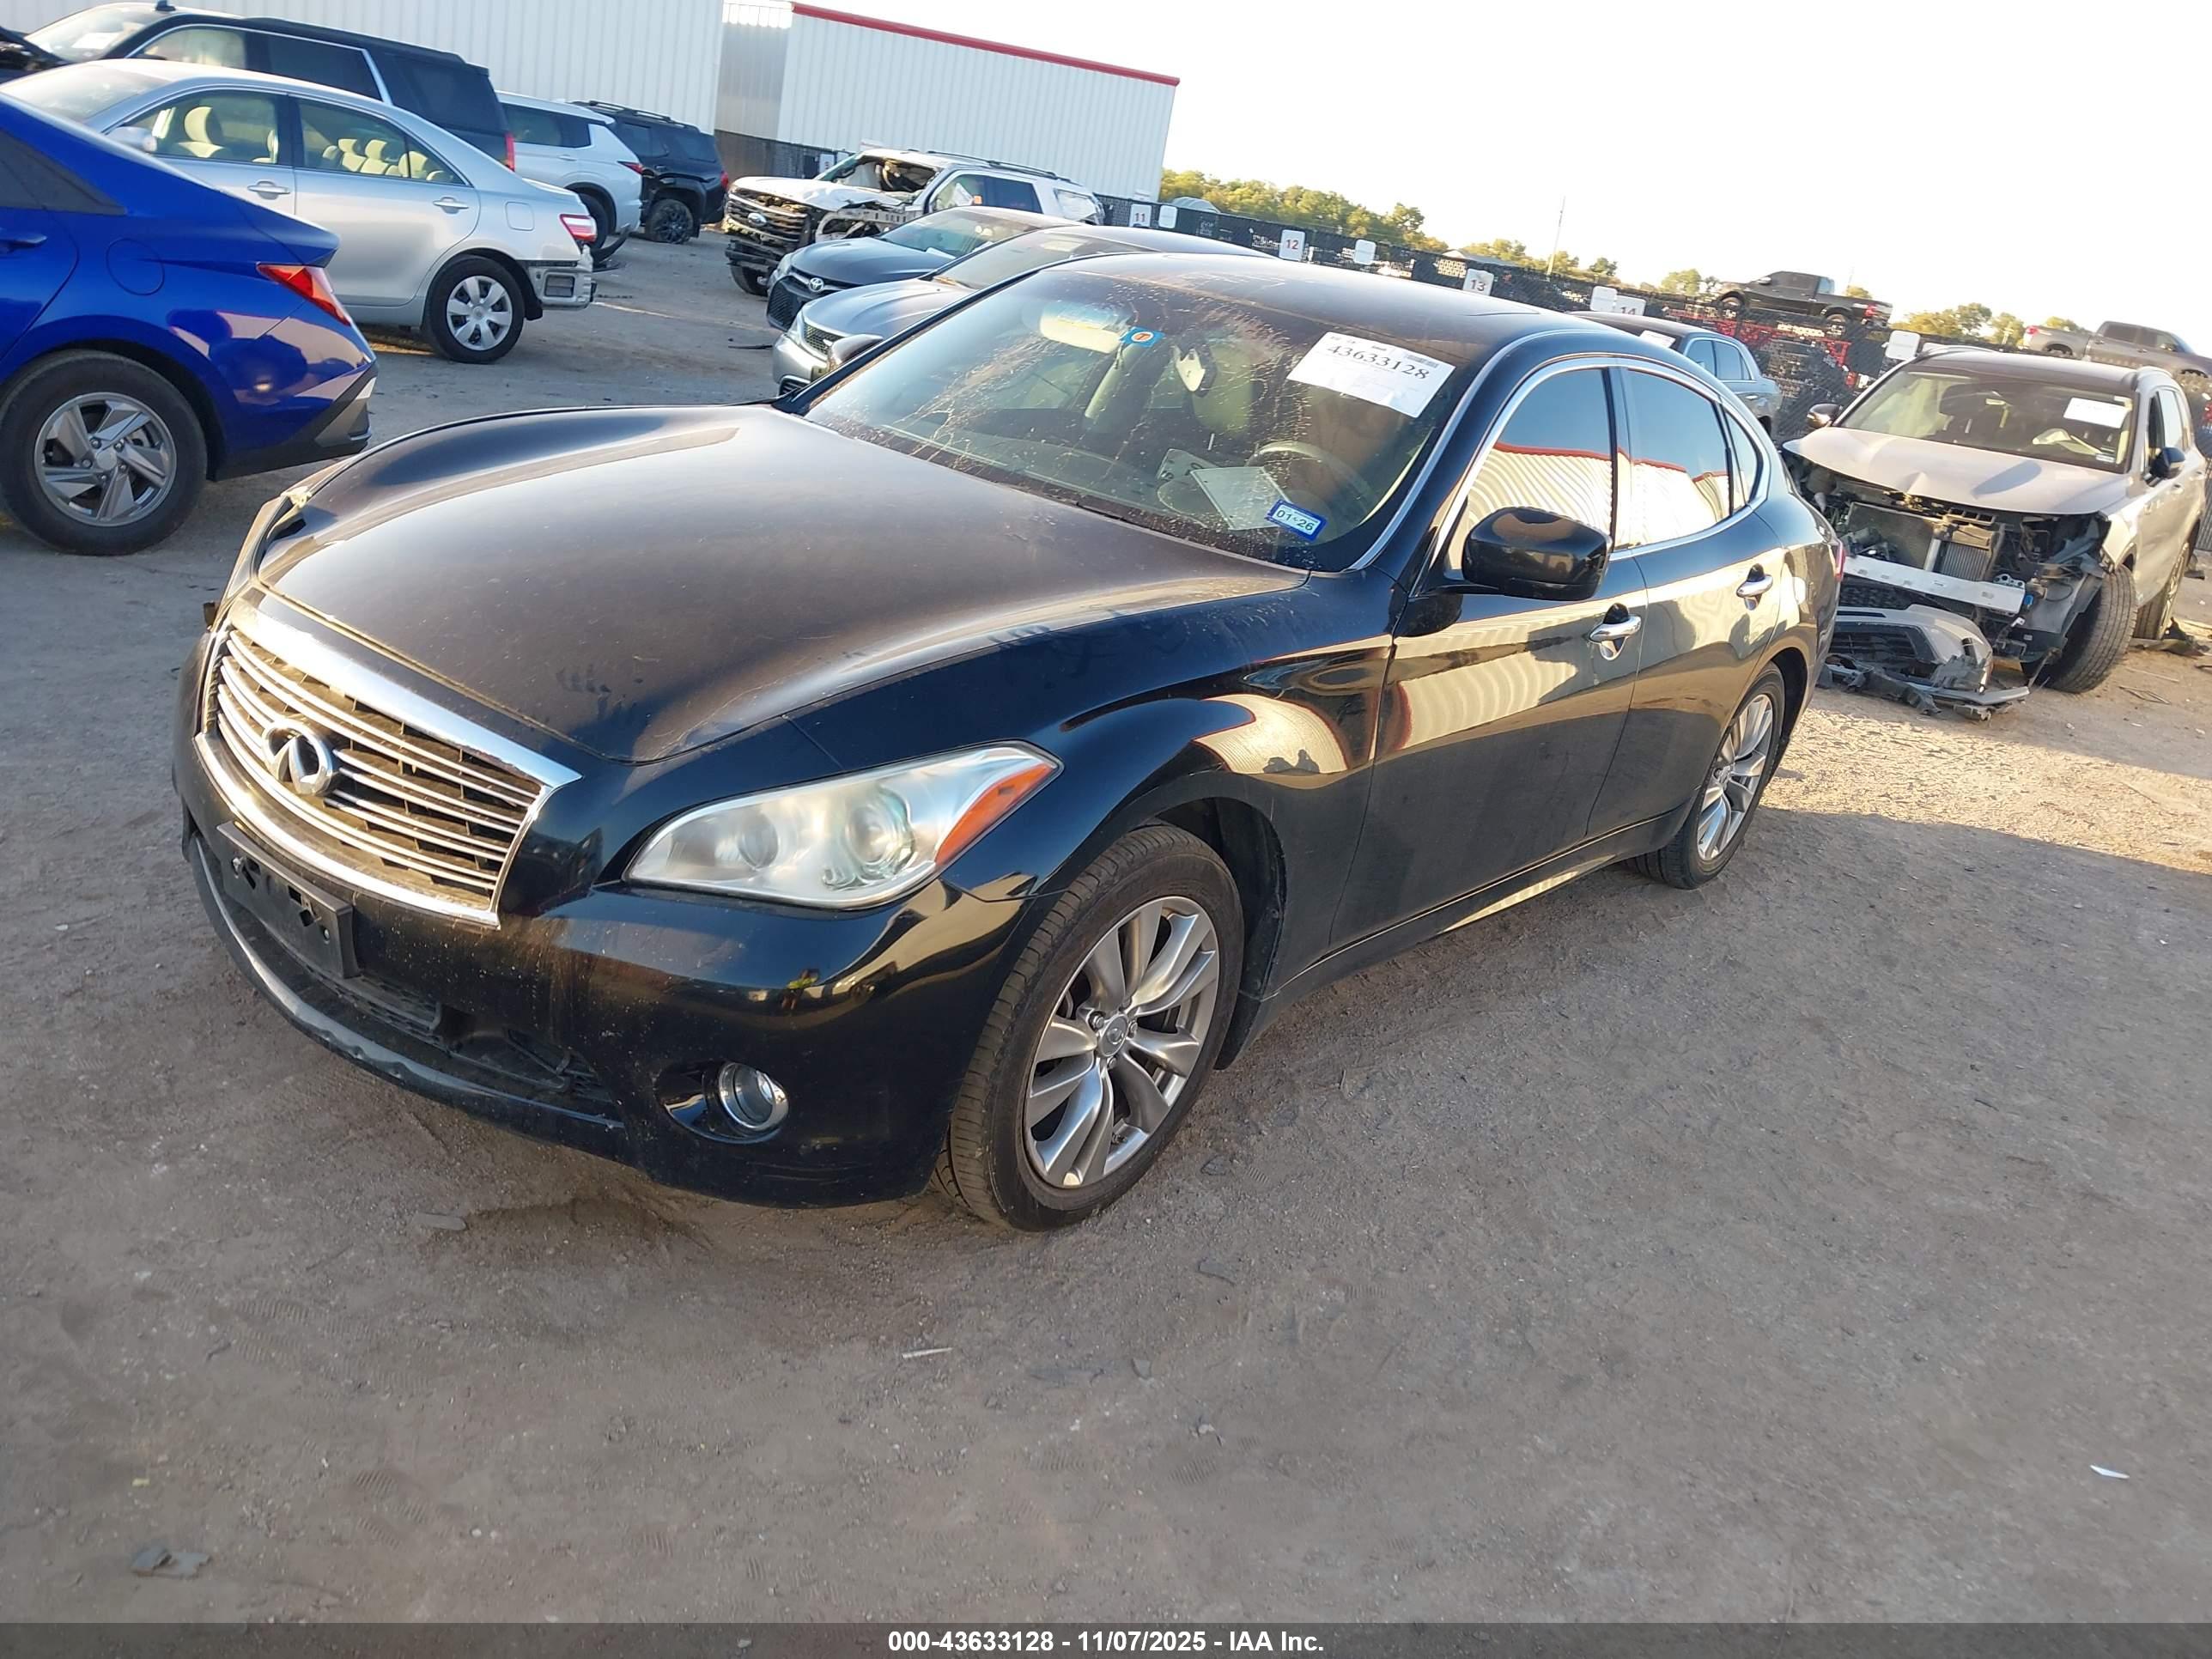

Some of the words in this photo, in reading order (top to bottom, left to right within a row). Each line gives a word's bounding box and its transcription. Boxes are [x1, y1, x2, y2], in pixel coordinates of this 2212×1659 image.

[1134, 212, 1146, 222] 11
[1285, 239, 1299, 250] 12
[1470, 279, 1486, 292] 13
[1620, 307, 1636, 315] 14
[1327, 345, 1431, 380] 43633128
